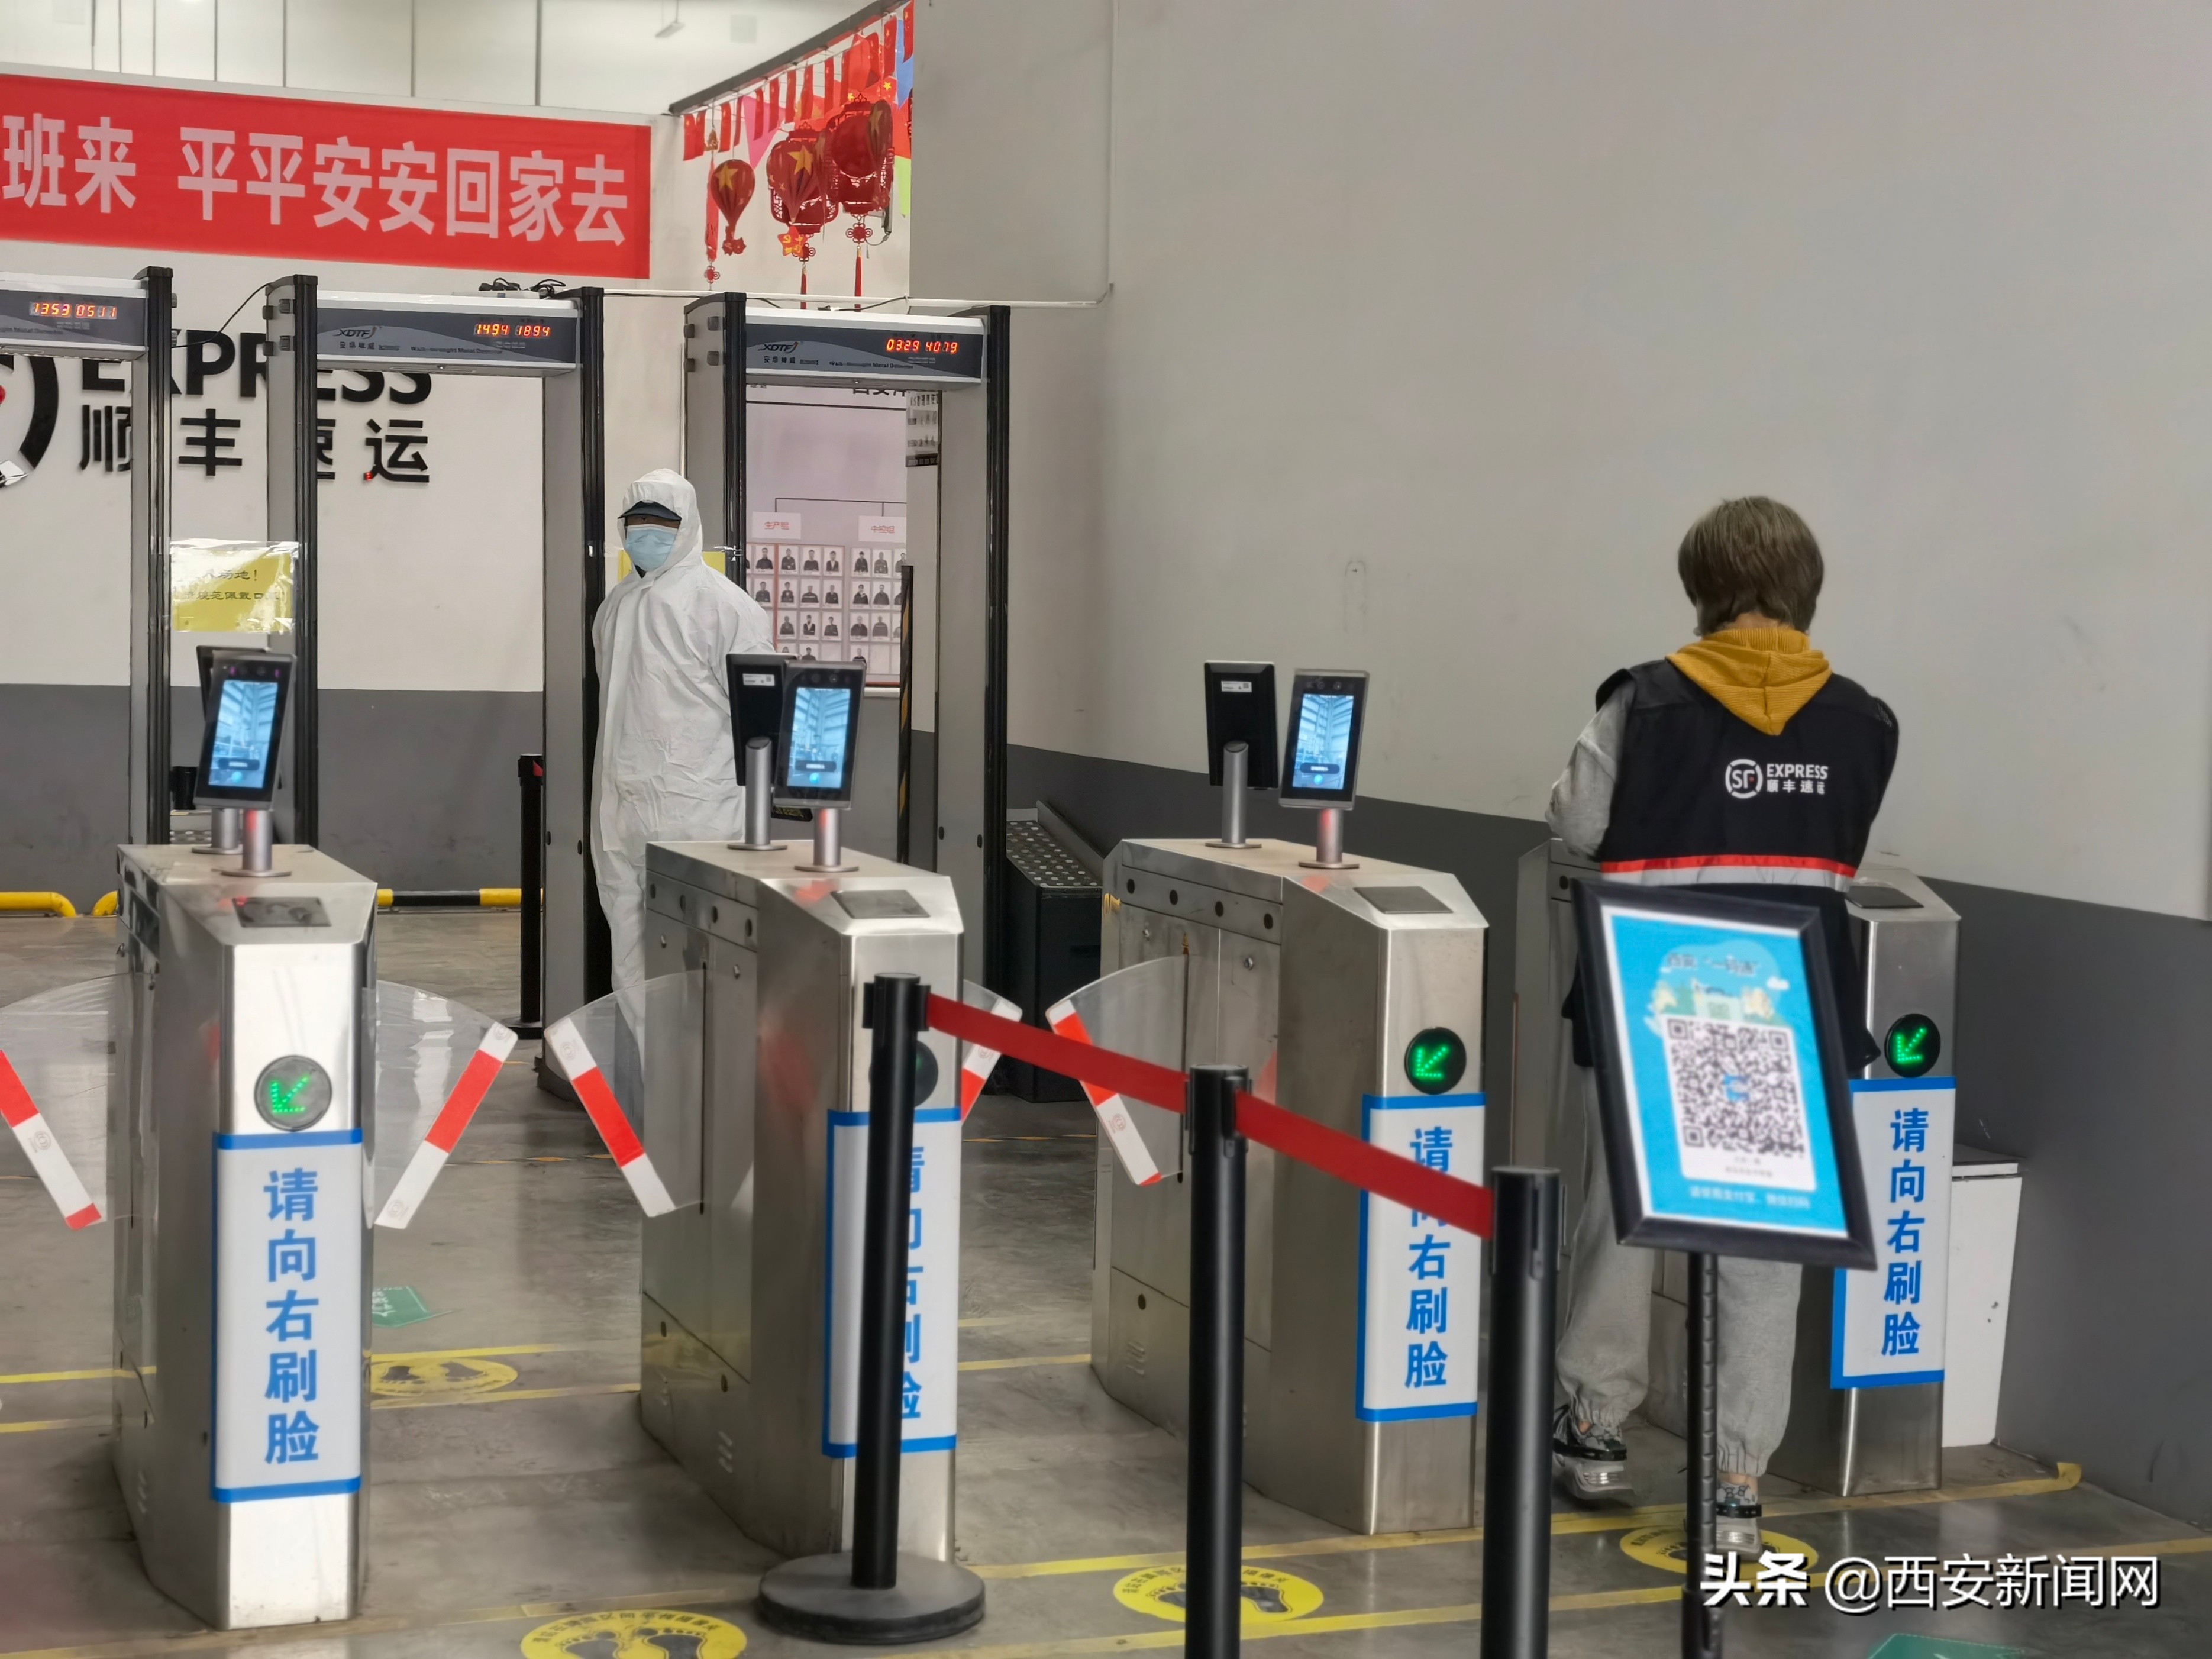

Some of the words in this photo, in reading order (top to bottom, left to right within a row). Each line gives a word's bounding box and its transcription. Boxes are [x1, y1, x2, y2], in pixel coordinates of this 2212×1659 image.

[2, 112, 137, 214] 班来
[178, 127, 629, 246] 平平安安回家去
[34, 302, 70, 316] 1353
[76, 304, 117, 318] 0511
[476, 323, 509, 335] 1494
[518, 325, 551, 337] 1894
[886, 338, 919, 353] 0329
[925, 340, 958, 354] 4079
[1766, 763, 1829, 780] EXPRESS
[1766, 779, 1825, 795] 顺丰速运
[1881, 1107, 1929, 1357] 请向右刷脸
[263, 1167, 320, 1465] 请向右刷脸
